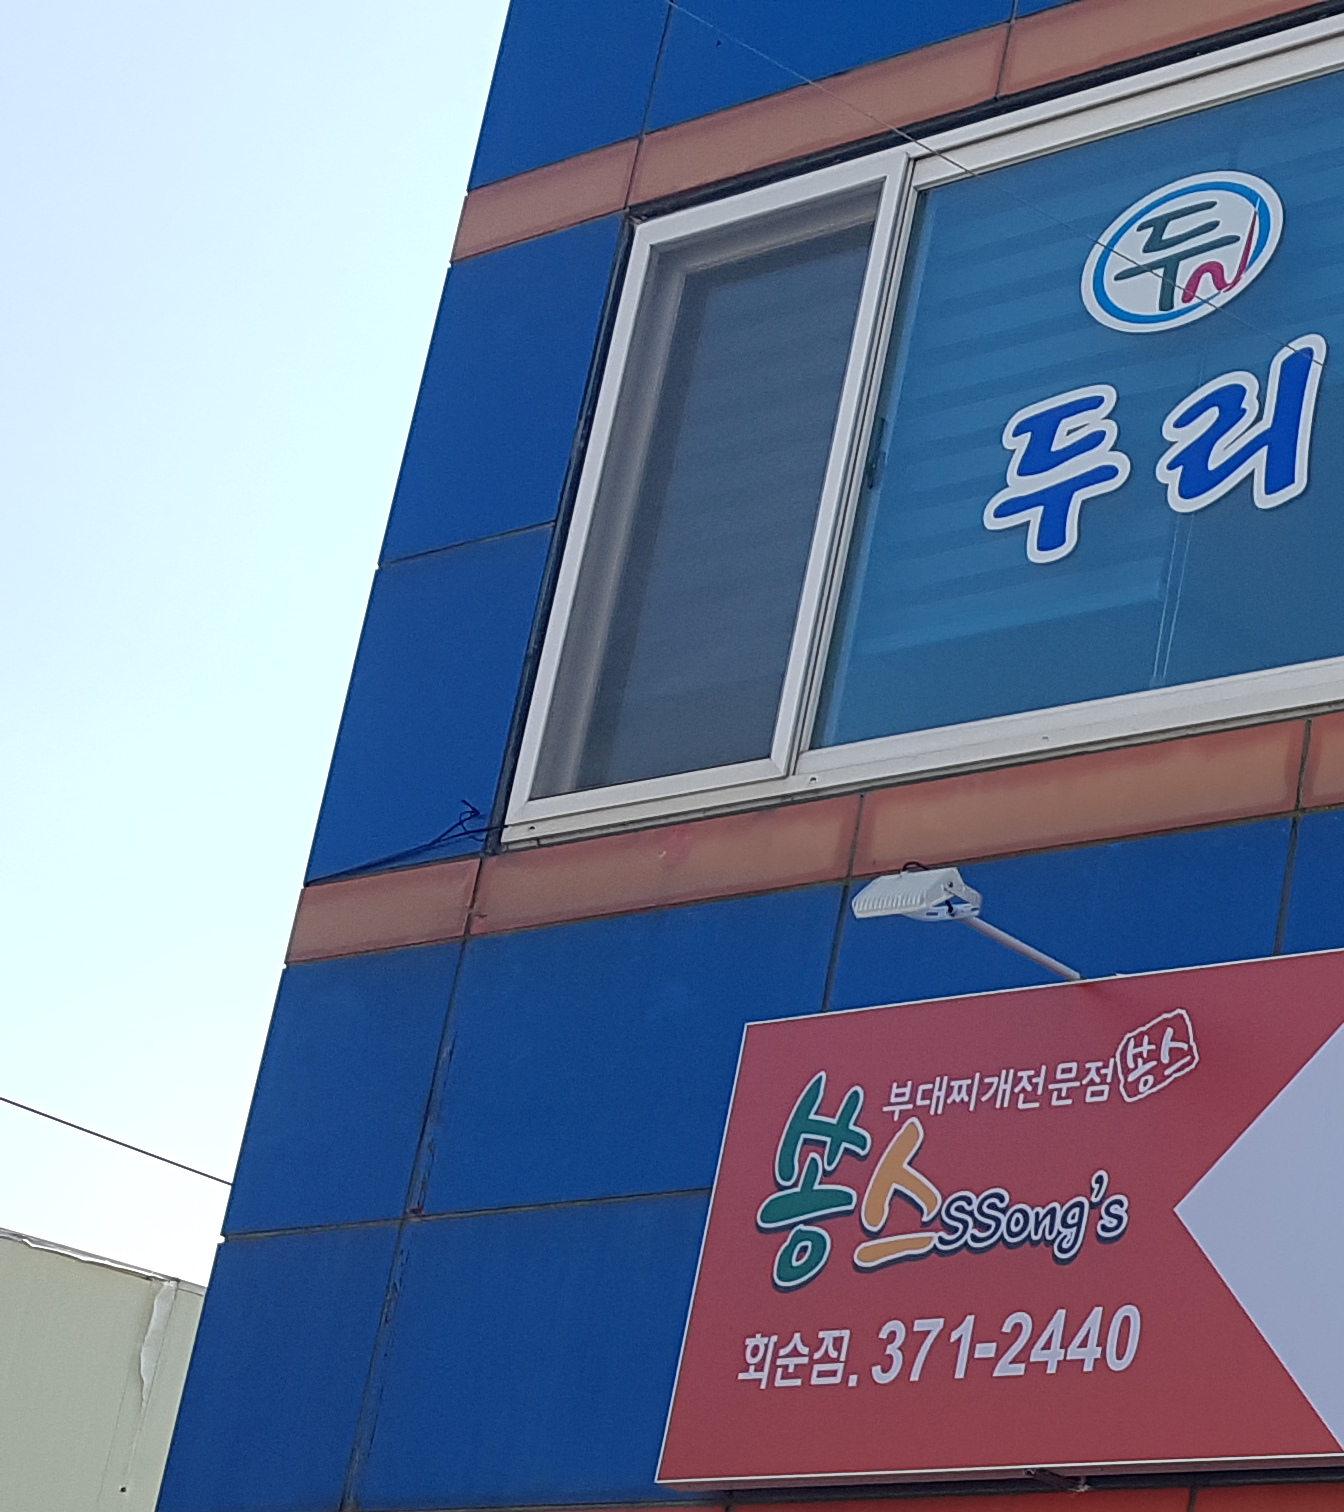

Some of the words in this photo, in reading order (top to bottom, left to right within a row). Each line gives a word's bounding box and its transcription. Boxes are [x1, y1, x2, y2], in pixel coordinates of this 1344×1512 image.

[984, 334, 1327, 563] 두리
[882, 1056, 1115, 1121] 부대찌개전문점
[871, 1304, 1141, 1385] 371-2440
